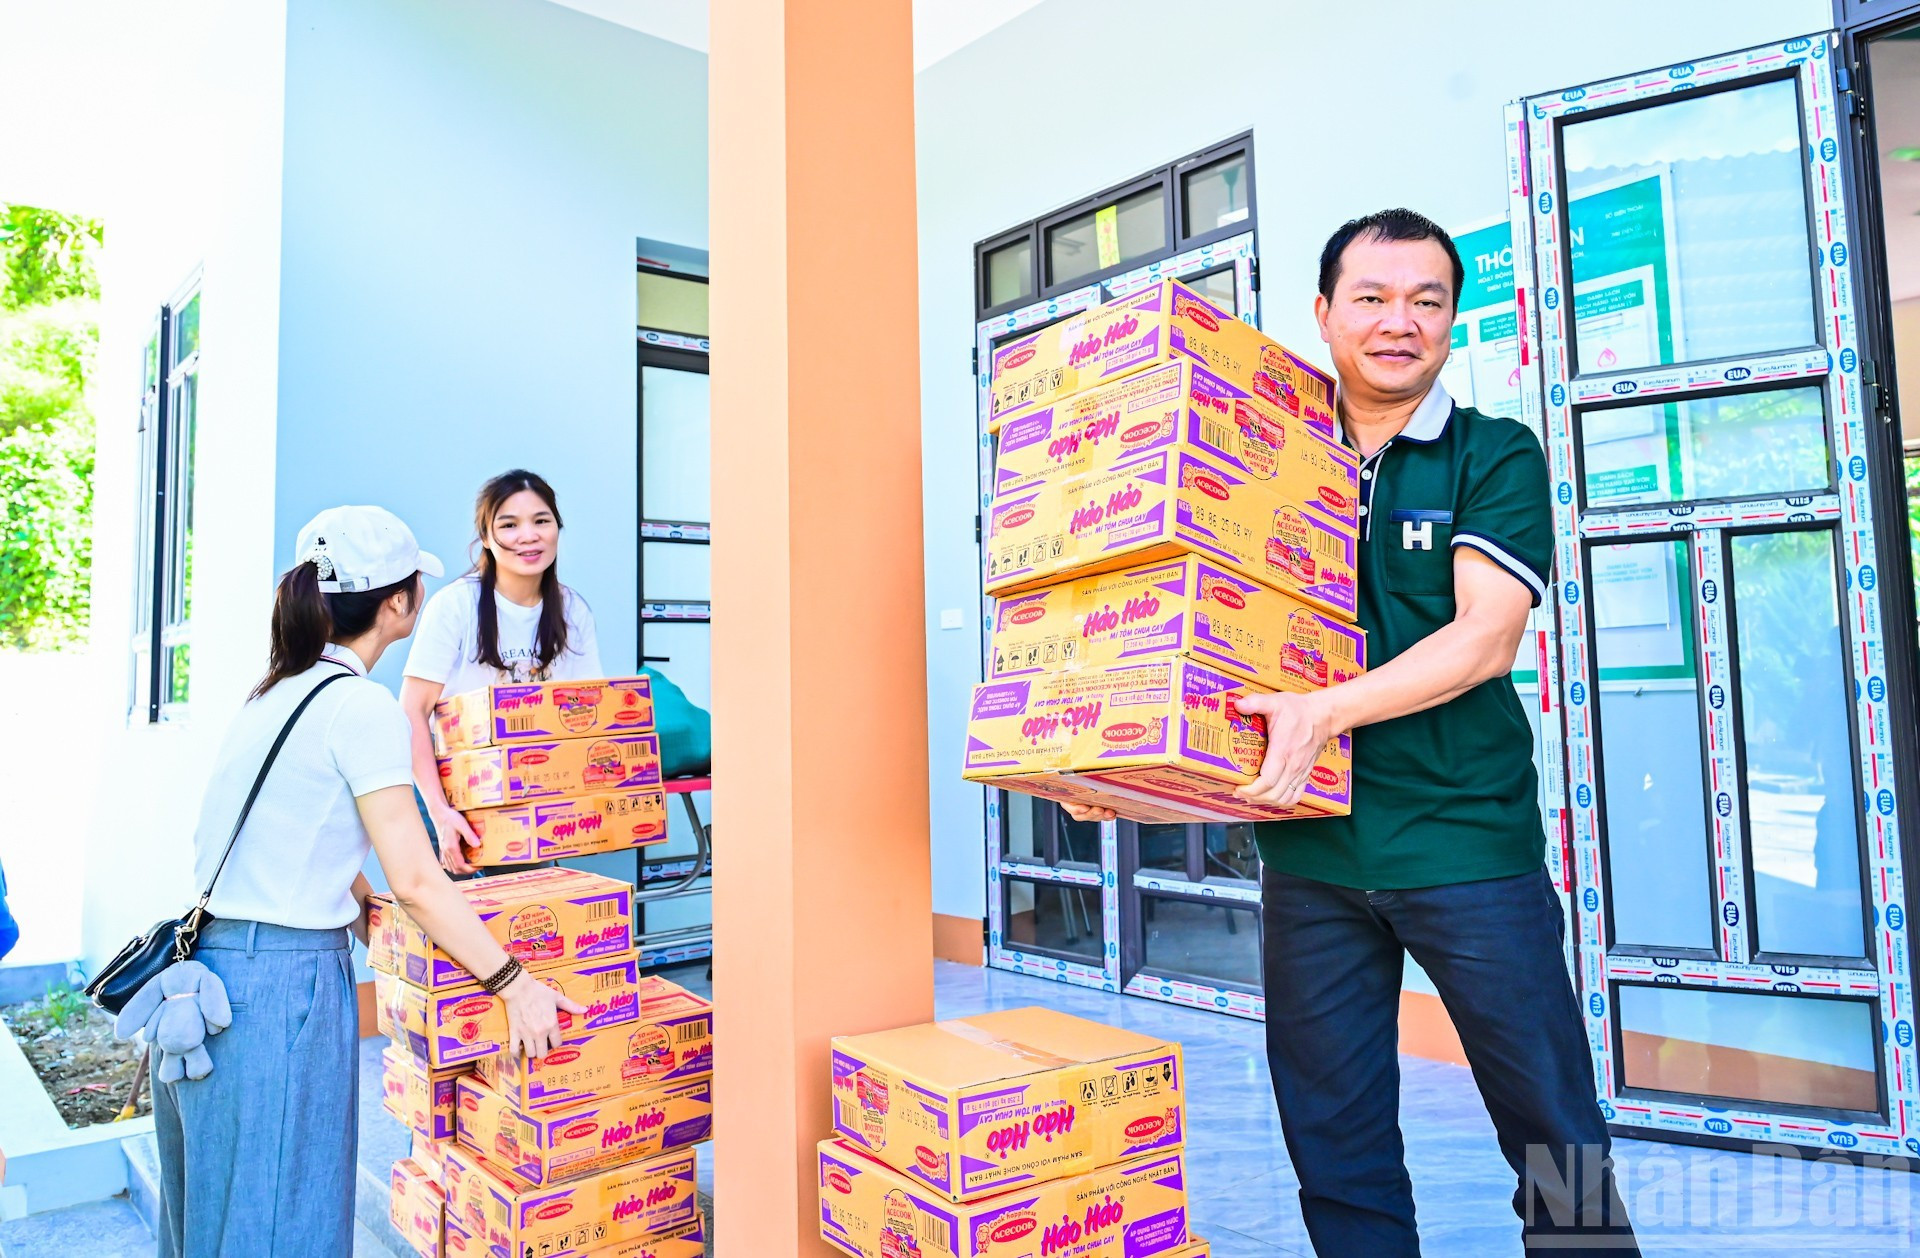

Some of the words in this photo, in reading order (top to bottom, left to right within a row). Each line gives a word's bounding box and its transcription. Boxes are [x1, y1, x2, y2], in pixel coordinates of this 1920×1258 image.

[1786, 40, 1809, 51] EUA
[1671, 66, 1692, 78] EUA
[1564, 90, 1583, 101] EUA
[1833, 244, 1845, 265] EUA
[1547, 289, 1557, 308] EUA
[1068, 333, 1101, 366] Hảo
[1103, 314, 1139, 347] Hảo
[1843, 350, 1853, 371] EUA
[1727, 368, 1748, 379] EUA
[1615, 382, 1635, 393] EUA
[1069, 500, 1104, 535] Hảo
[1105, 482, 1142, 518] Hảo
[1861, 567, 1873, 588] EUA
[1567, 583, 1577, 602] EUA
[1704, 581, 1715, 601] EUA
[1082, 604, 1120, 638] Hảo
[1120, 590, 1161, 625] Hảo
[1711, 687, 1722, 707] EUA
[1870, 678, 1883, 700] EUA
[1719, 795, 1730, 815] EUA
[1726, 905, 1737, 925] EUA
[1889, 907, 1900, 928] EUA
[575, 929, 600, 950] Hảo
[600, 922, 625, 942] Hảo
[1898, 1024, 1909, 1045] EUA
[601, 1121, 633, 1149] Hảo
[634, 1107, 665, 1134] Hảo
[1033, 1104, 1075, 1143] Hảo
[1708, 1121, 1729, 1131] EUA
[986, 1120, 1031, 1160] Hảo
[1076, 1191, 1089, 1202] SẢN
[1089, 1185, 1106, 1198] PHẨM
[1105, 1182, 1116, 1193] VỚI
[1115, 1177, 1132, 1190] CÔNG
[1132, 1171, 1148, 1185] NGHỆ
[1148, 1168, 1162, 1180] NHẬT
[1163, 1164, 1175, 1175] BẢN
[612, 1194, 644, 1221] Hảo
[646, 1181, 677, 1208] Hảo
[1040, 1214, 1082, 1257] Hảo
[1083, 1194, 1124, 1237] Hảo
